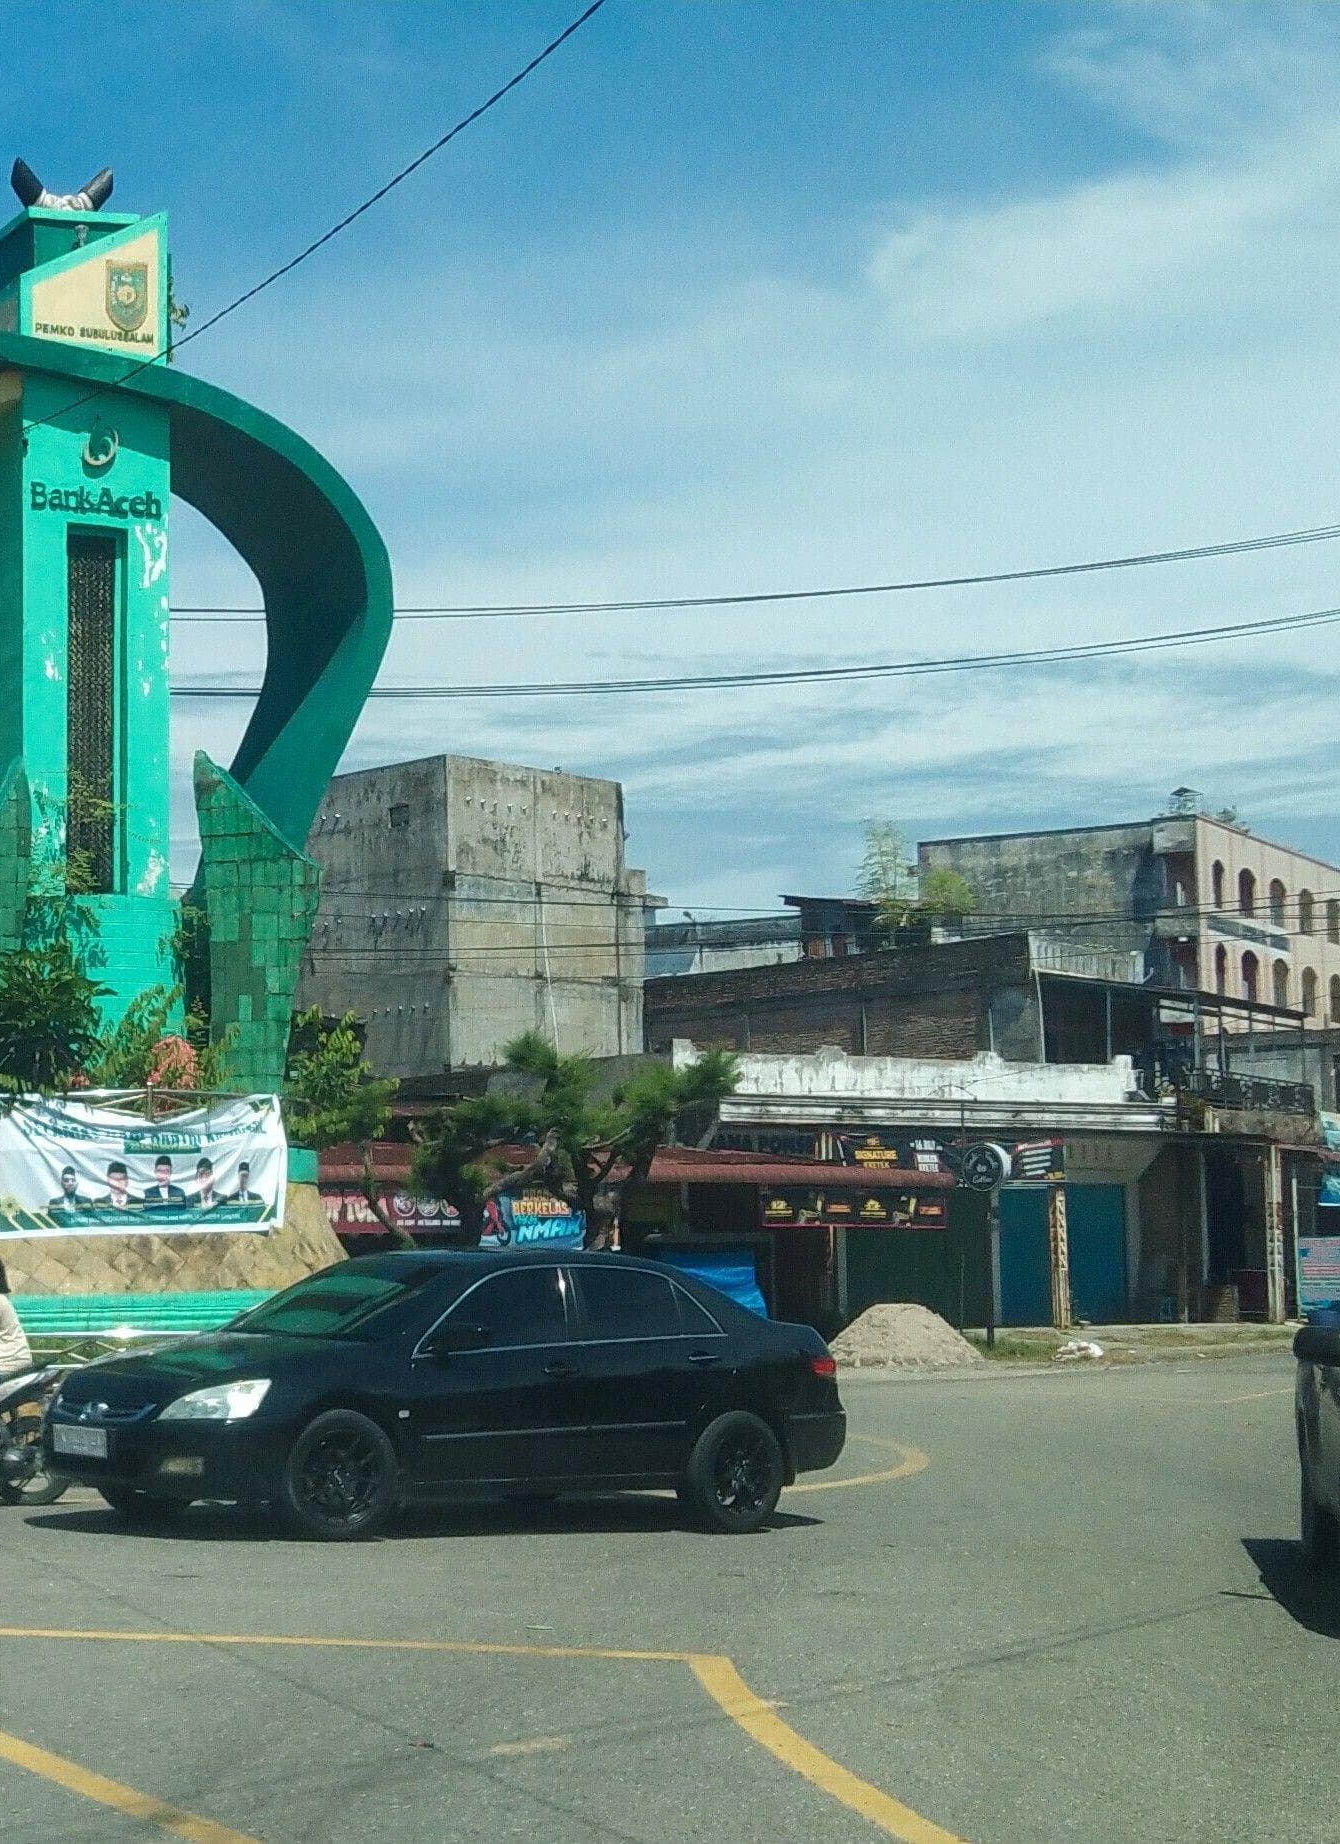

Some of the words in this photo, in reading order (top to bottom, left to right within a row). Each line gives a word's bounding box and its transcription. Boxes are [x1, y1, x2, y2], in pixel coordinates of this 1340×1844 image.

[35, 323, 75, 337] PEMKO
[80, 327, 154, 345] SUBULUSSALAM
[31, 481, 94, 514] Bank
[99, 487, 162, 520] Aceh
